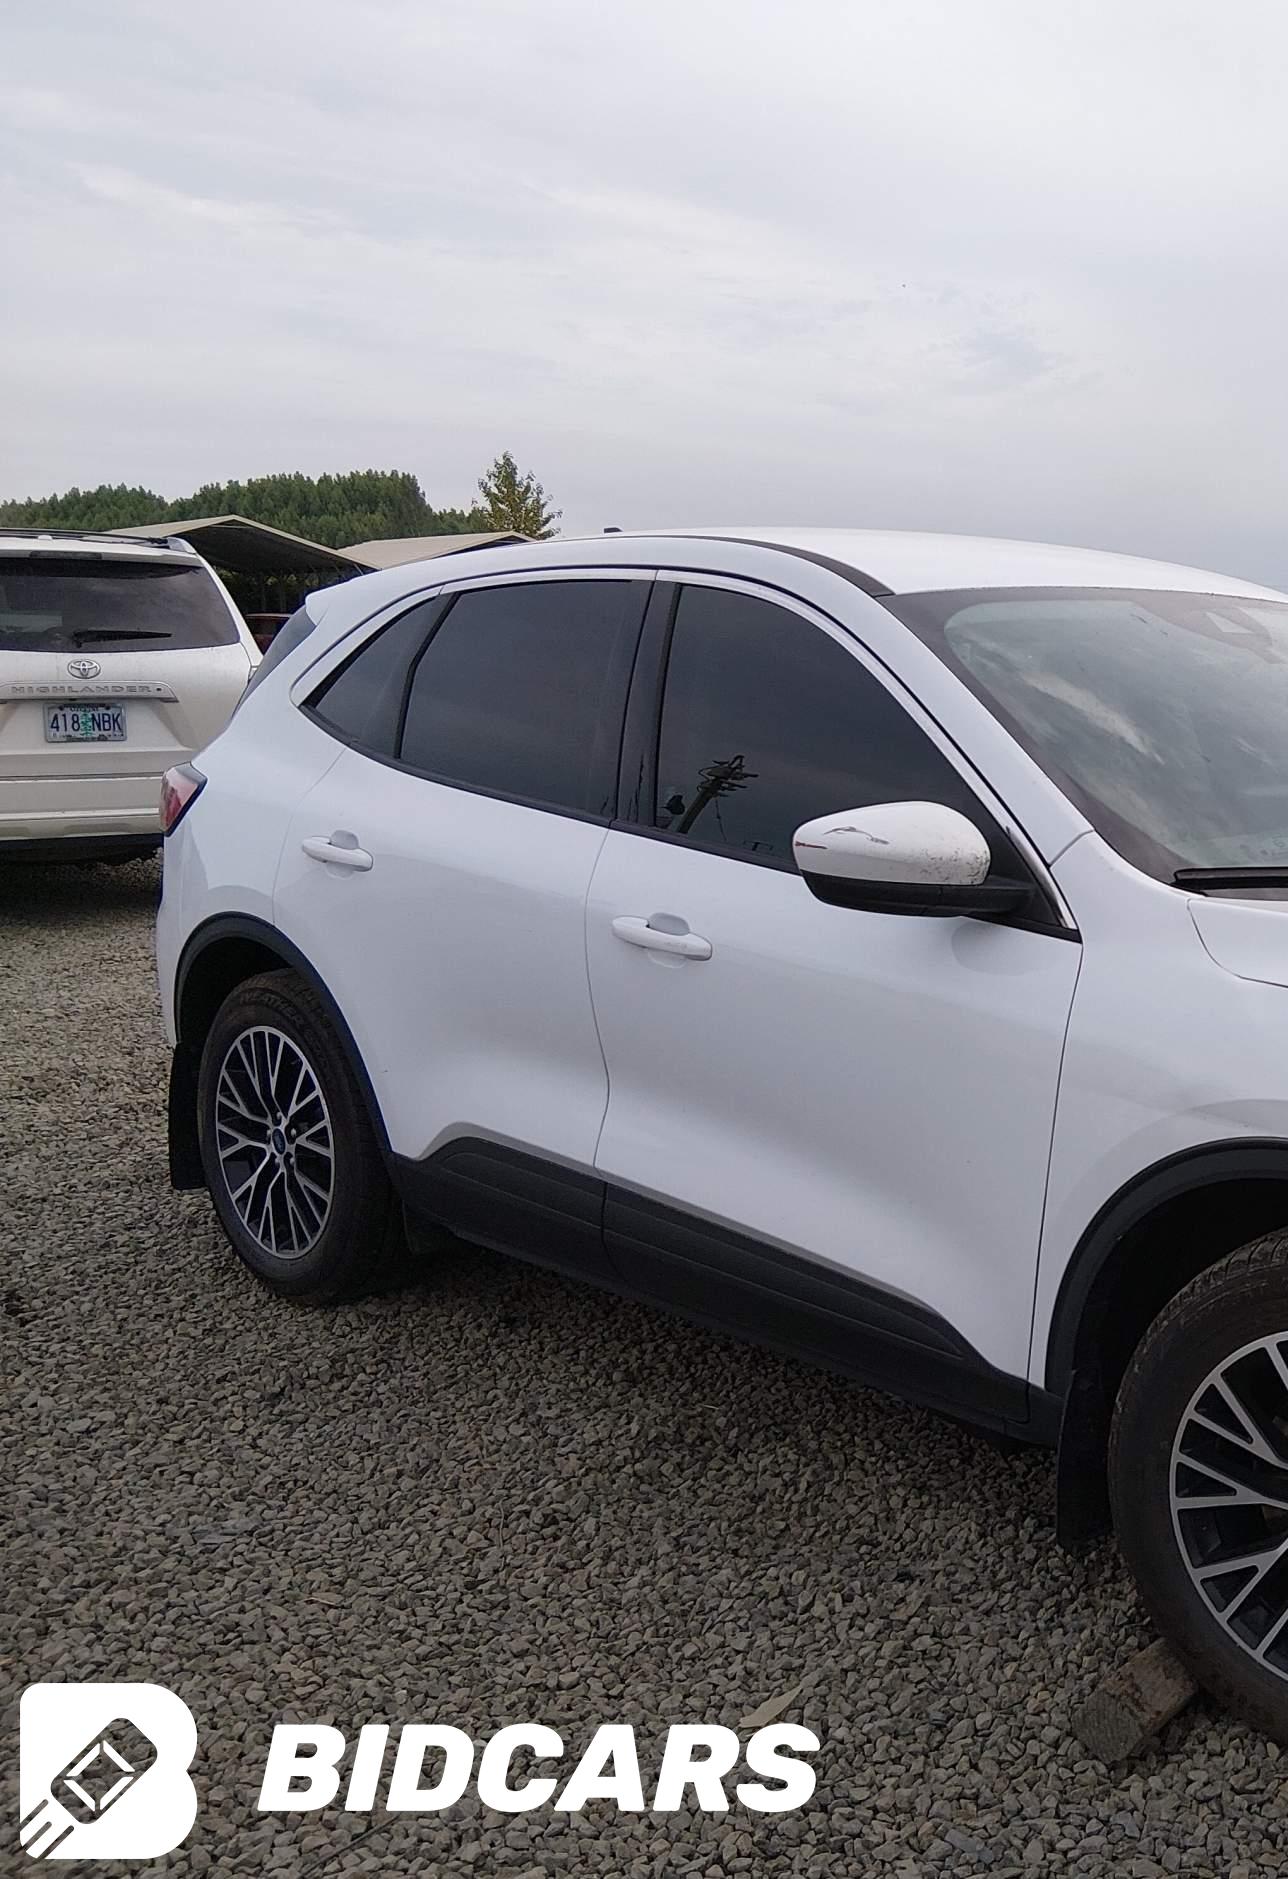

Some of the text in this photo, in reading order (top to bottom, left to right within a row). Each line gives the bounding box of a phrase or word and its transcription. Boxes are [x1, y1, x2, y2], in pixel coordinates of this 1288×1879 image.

[11, 685, 151, 694] HIGHLANDER
[51, 713, 122, 732] 418 NBK
